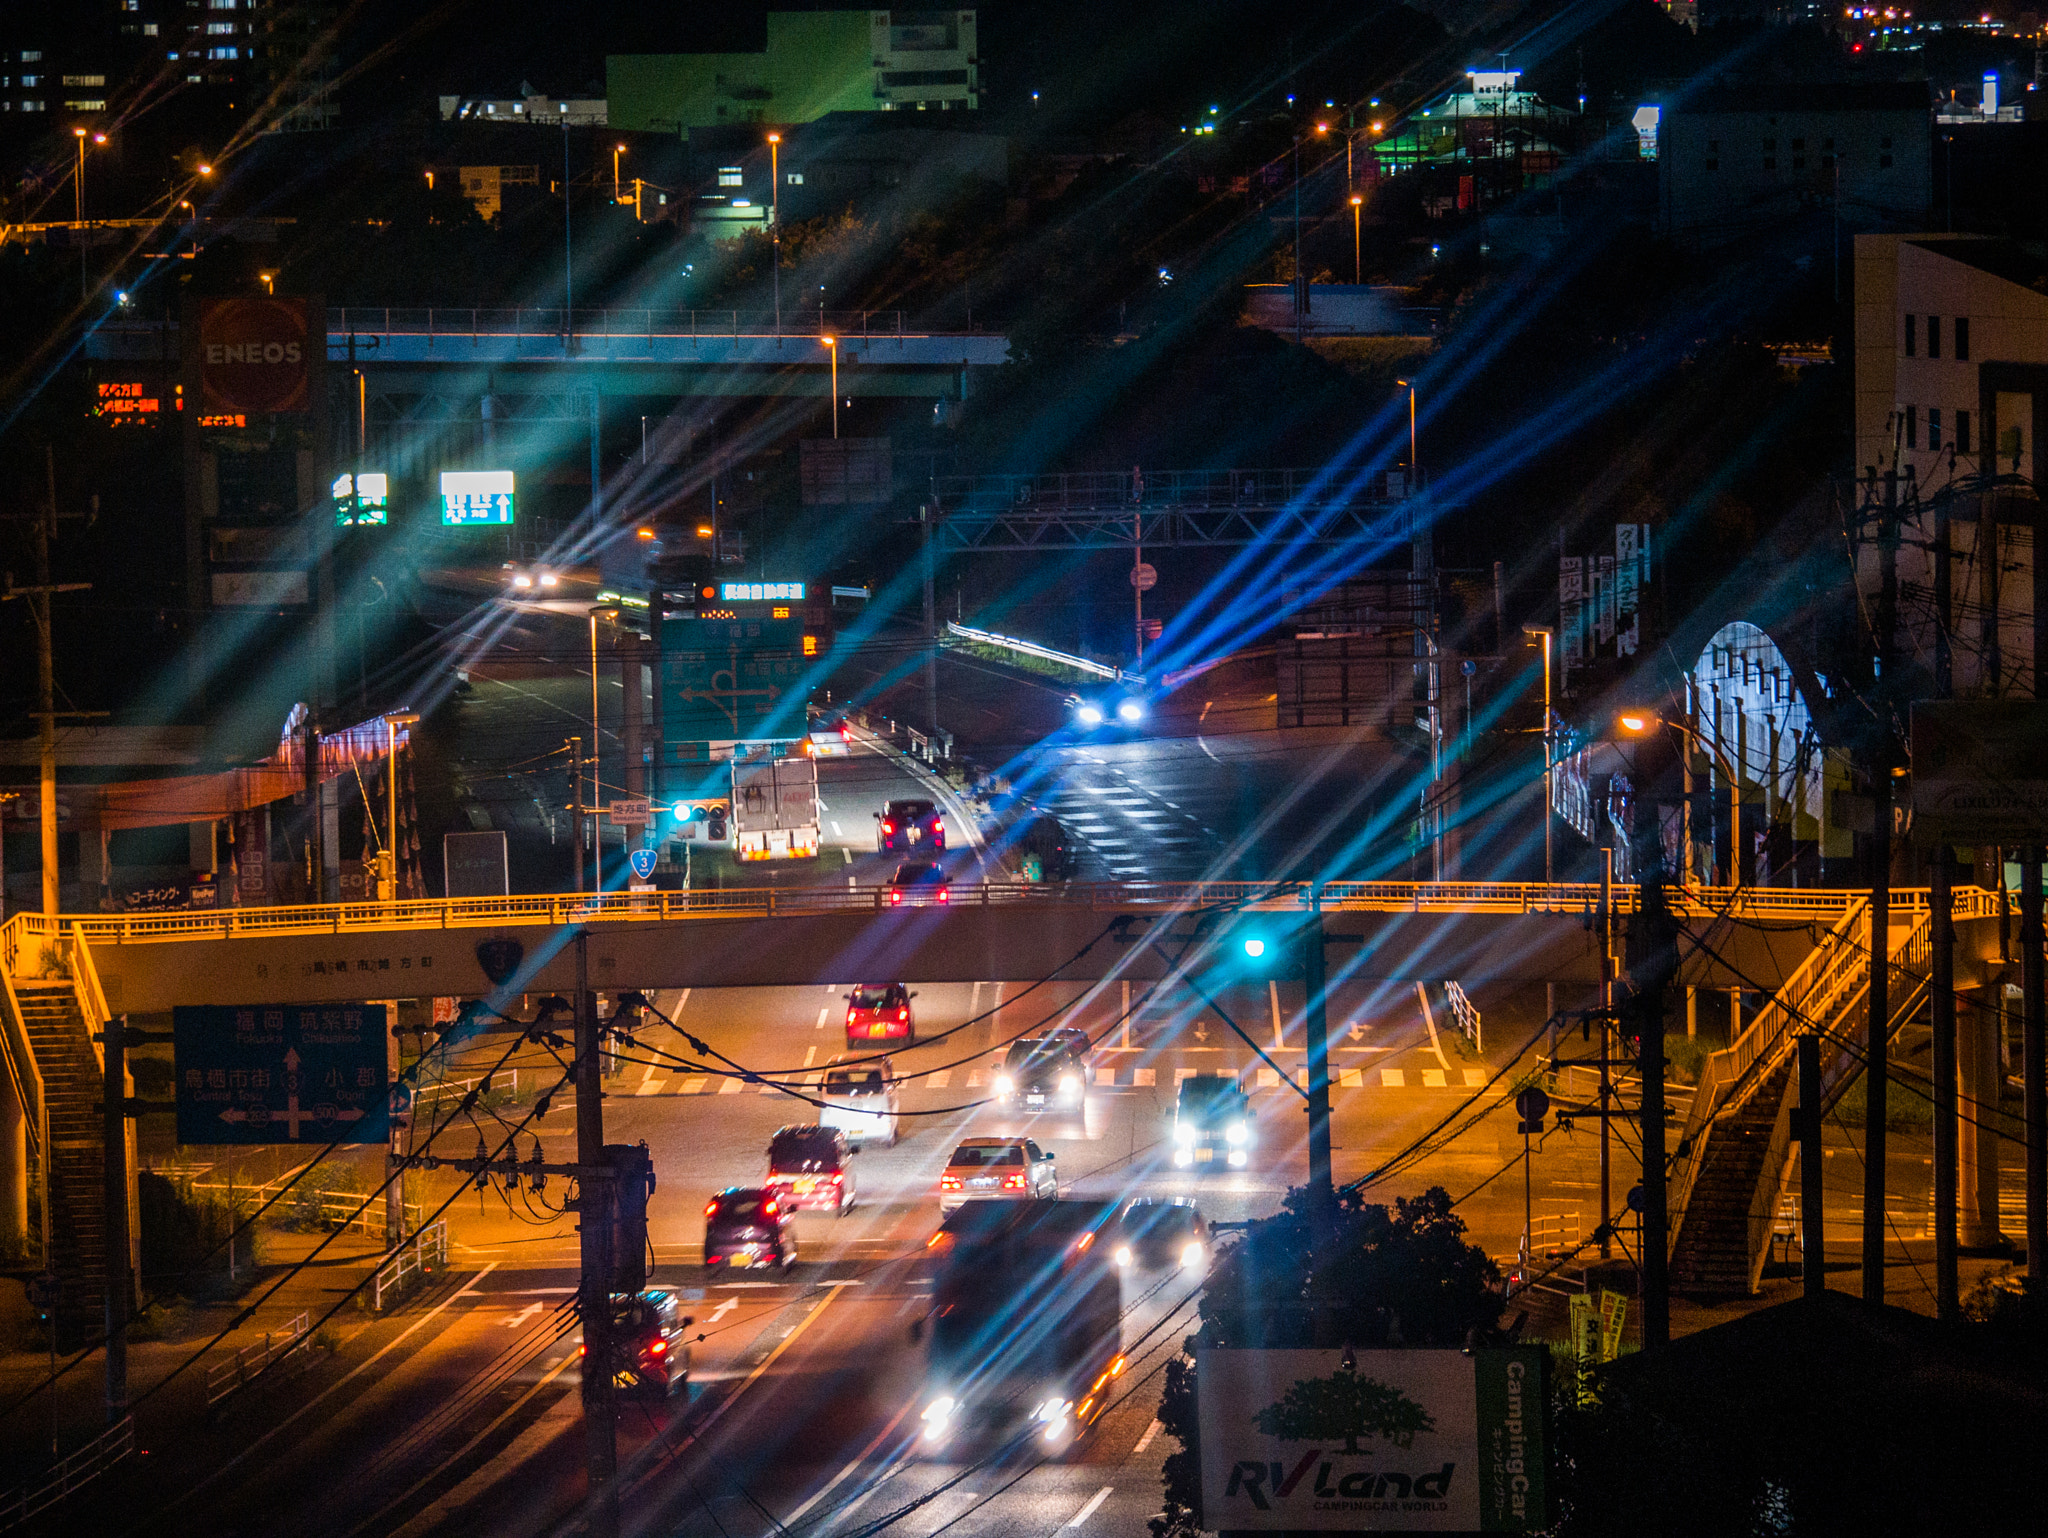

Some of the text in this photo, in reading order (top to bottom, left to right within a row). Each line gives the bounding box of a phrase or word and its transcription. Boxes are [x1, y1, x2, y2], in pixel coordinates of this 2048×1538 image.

[206, 342, 301, 364] ENEOS
[773, 607, 789, 619] 雨
[640, 857, 648, 868] 3
[236, 1010, 362, 1031] 福岡 筑紫野
[185, 1068, 270, 1089] 鳥栖市街
[287, 1075, 297, 1090] 3
[325, 1067, 376, 1087] 小郡
[1505, 1361, 1530, 1520] CampingCar
[1224, 1449, 1456, 1511] RV Land
[1401, 1501, 1448, 1512] WORLD
